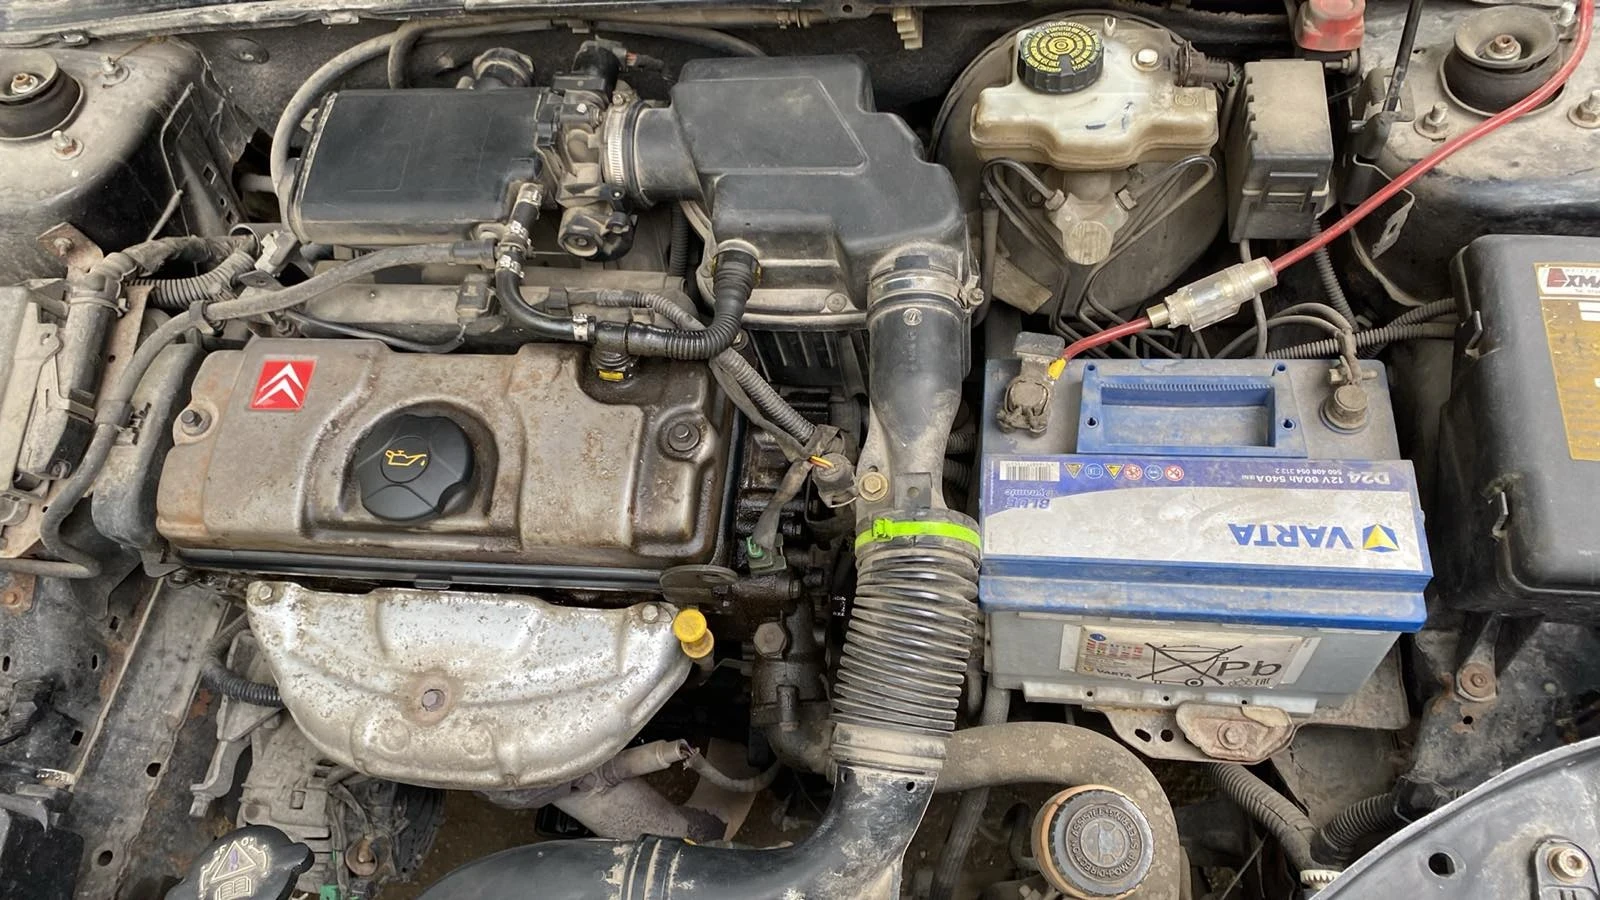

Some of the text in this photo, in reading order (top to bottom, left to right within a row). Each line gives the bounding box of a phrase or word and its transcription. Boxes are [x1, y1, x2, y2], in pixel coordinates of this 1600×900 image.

[1289, 475, 1318, 484] 60Ah
[1322, 476, 1344, 484] 12V
[1347, 471, 1391, 485] D24
[1005, 497, 1051, 509] BLUE
[1227, 522, 1354, 550] VARTA
[1096, 668, 1133, 678] VARTA
[1217, 660, 1282, 677] Pb
